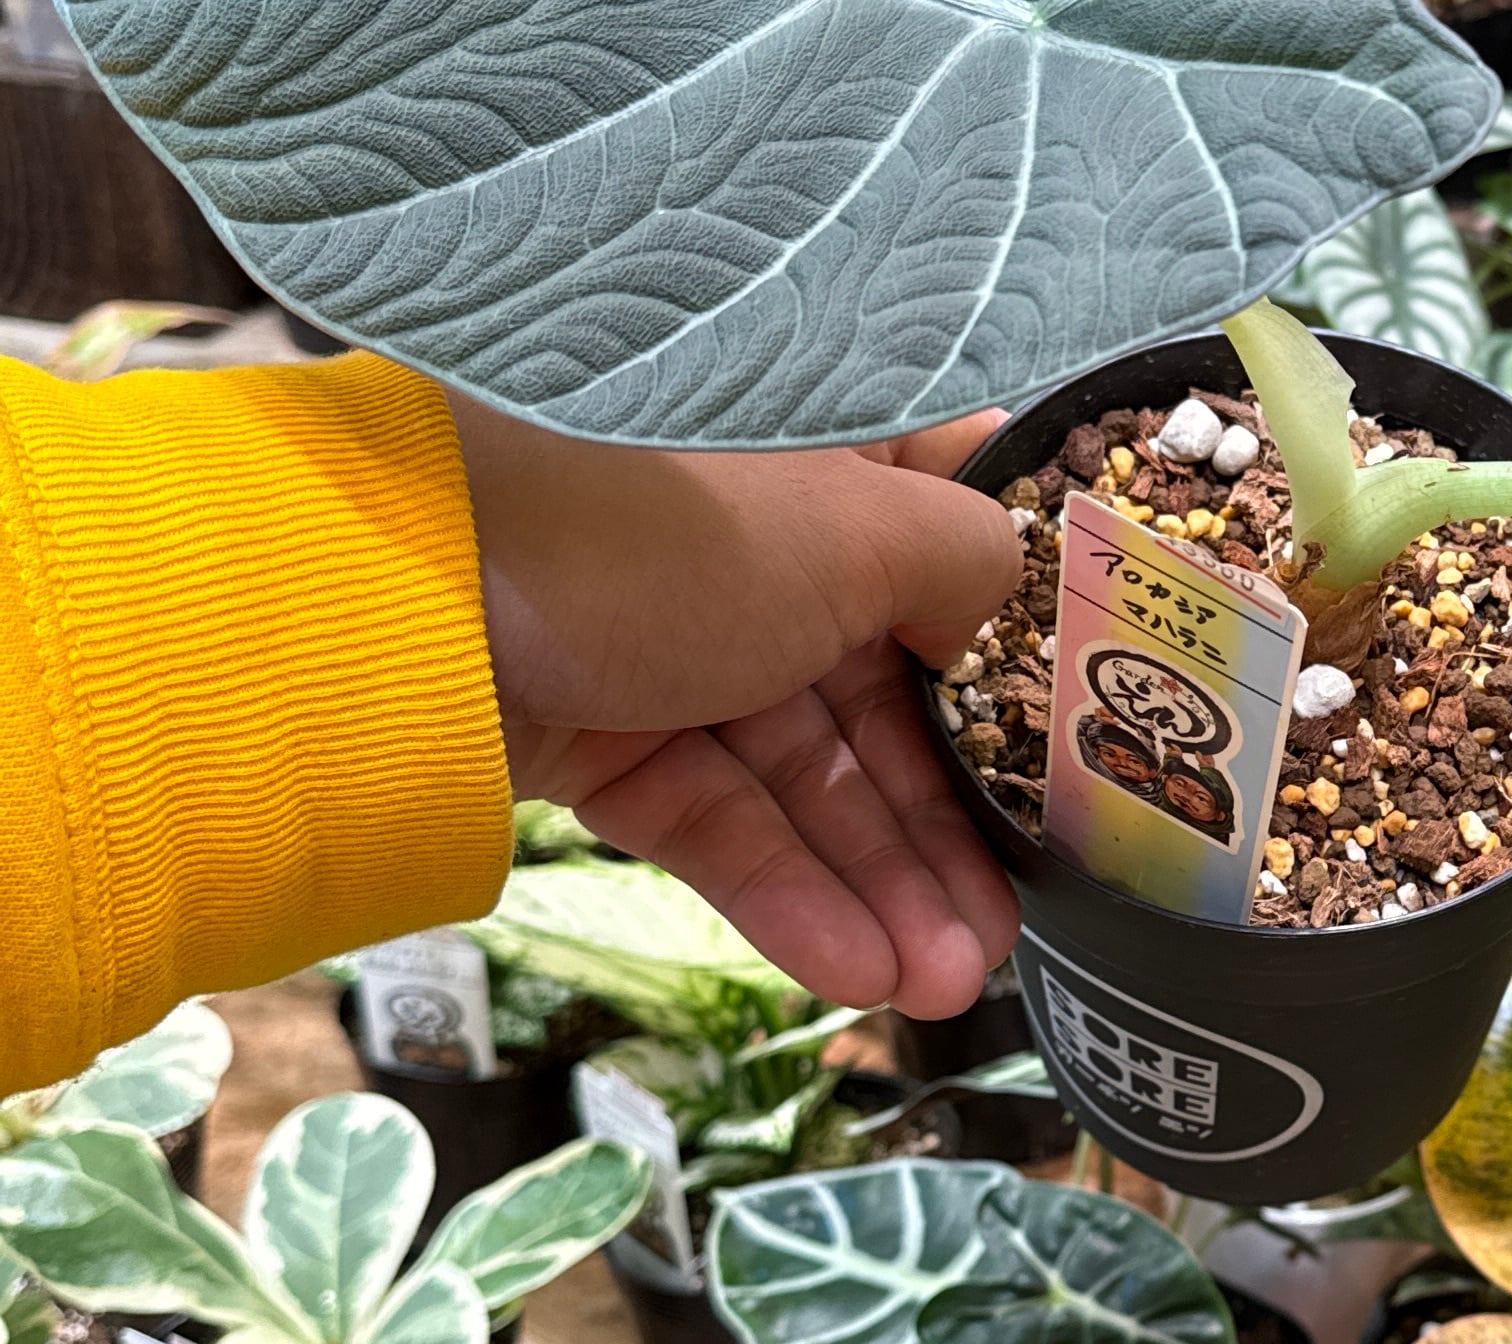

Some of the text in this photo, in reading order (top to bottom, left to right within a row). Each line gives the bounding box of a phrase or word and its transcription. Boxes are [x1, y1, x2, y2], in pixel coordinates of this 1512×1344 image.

[1122, 598, 1228, 666] マハラニ
[1112, 659, 1165, 693] Garden
